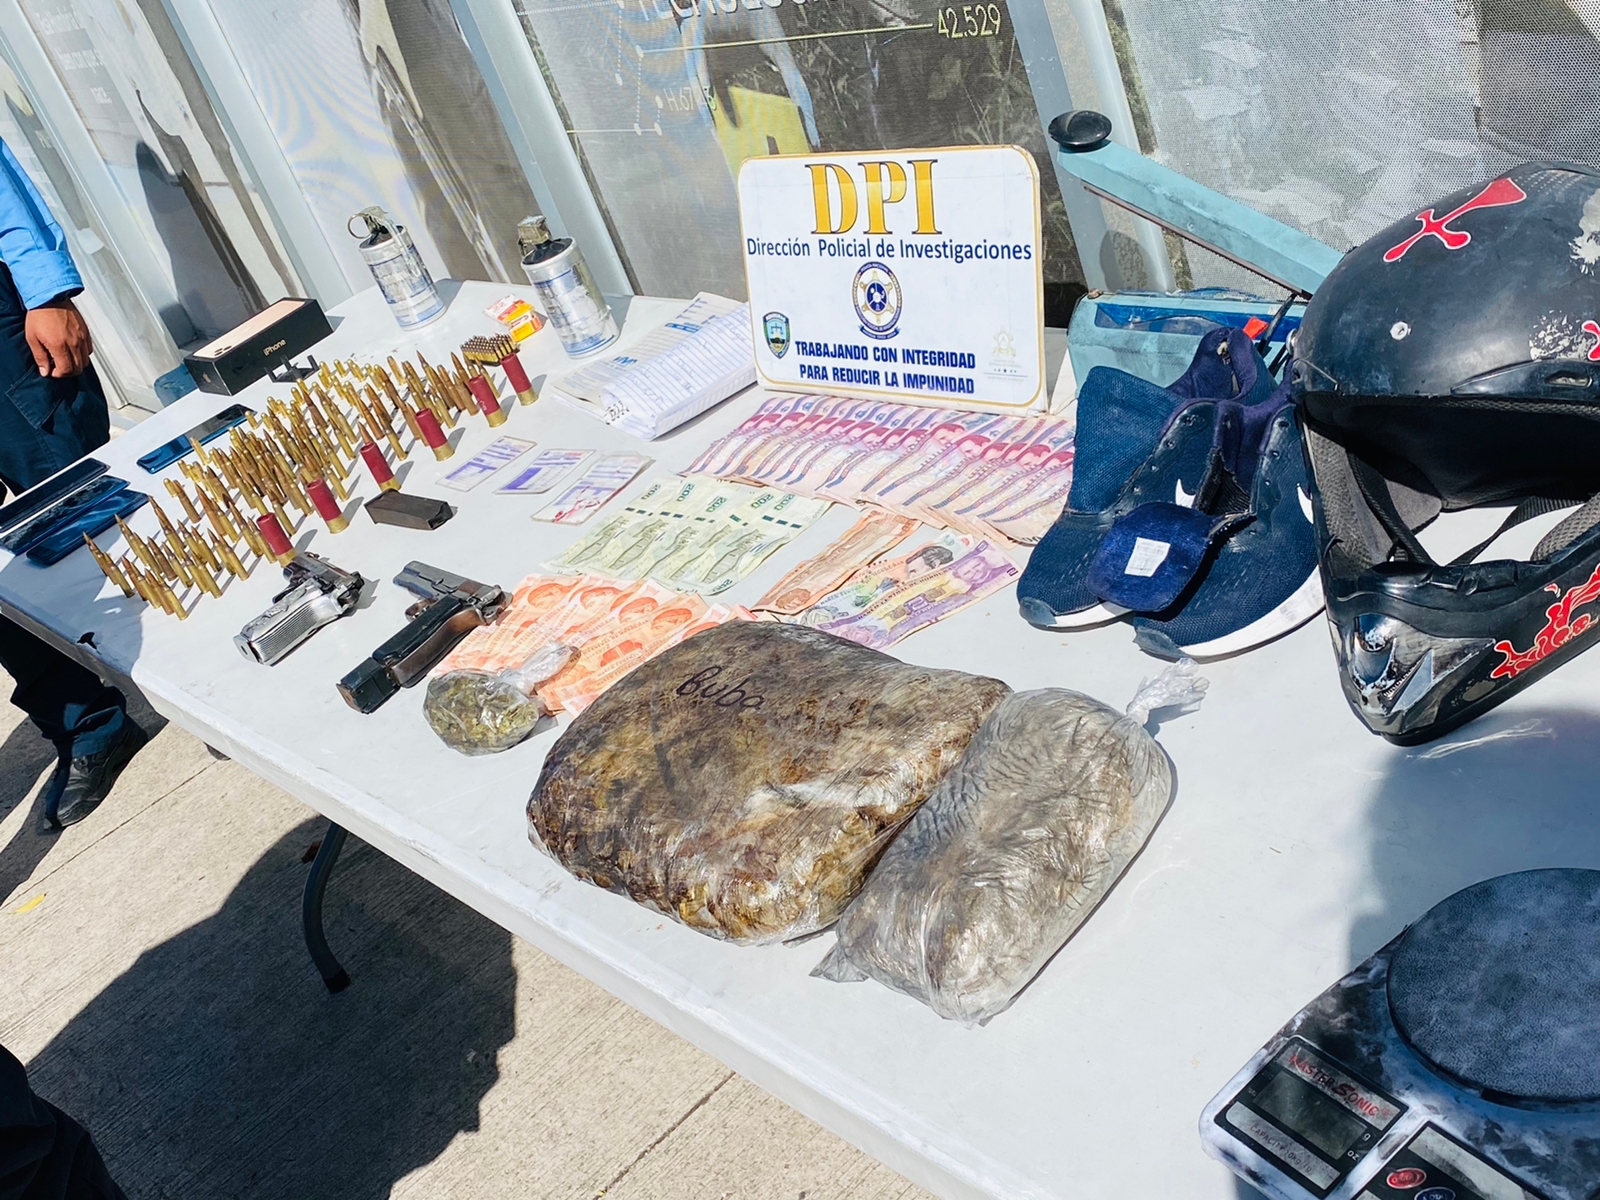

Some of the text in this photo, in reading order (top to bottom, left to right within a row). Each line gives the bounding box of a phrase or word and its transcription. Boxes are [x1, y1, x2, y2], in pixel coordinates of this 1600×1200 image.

[938, 3, 1001, 38] 42.529
[805, 159, 942, 235] DPI
[746, 237, 1032, 264] Dirección Policial de Investigaciones
[263, 339, 286, 356] iPhone
[795, 341, 868, 361] TRABAJANDO
[873, 346, 898, 363] CON
[902, 348, 976, 369] INTEGRIDAD
[799, 364, 974, 394] PARA REDUCIR LA IMPUNIDAD
